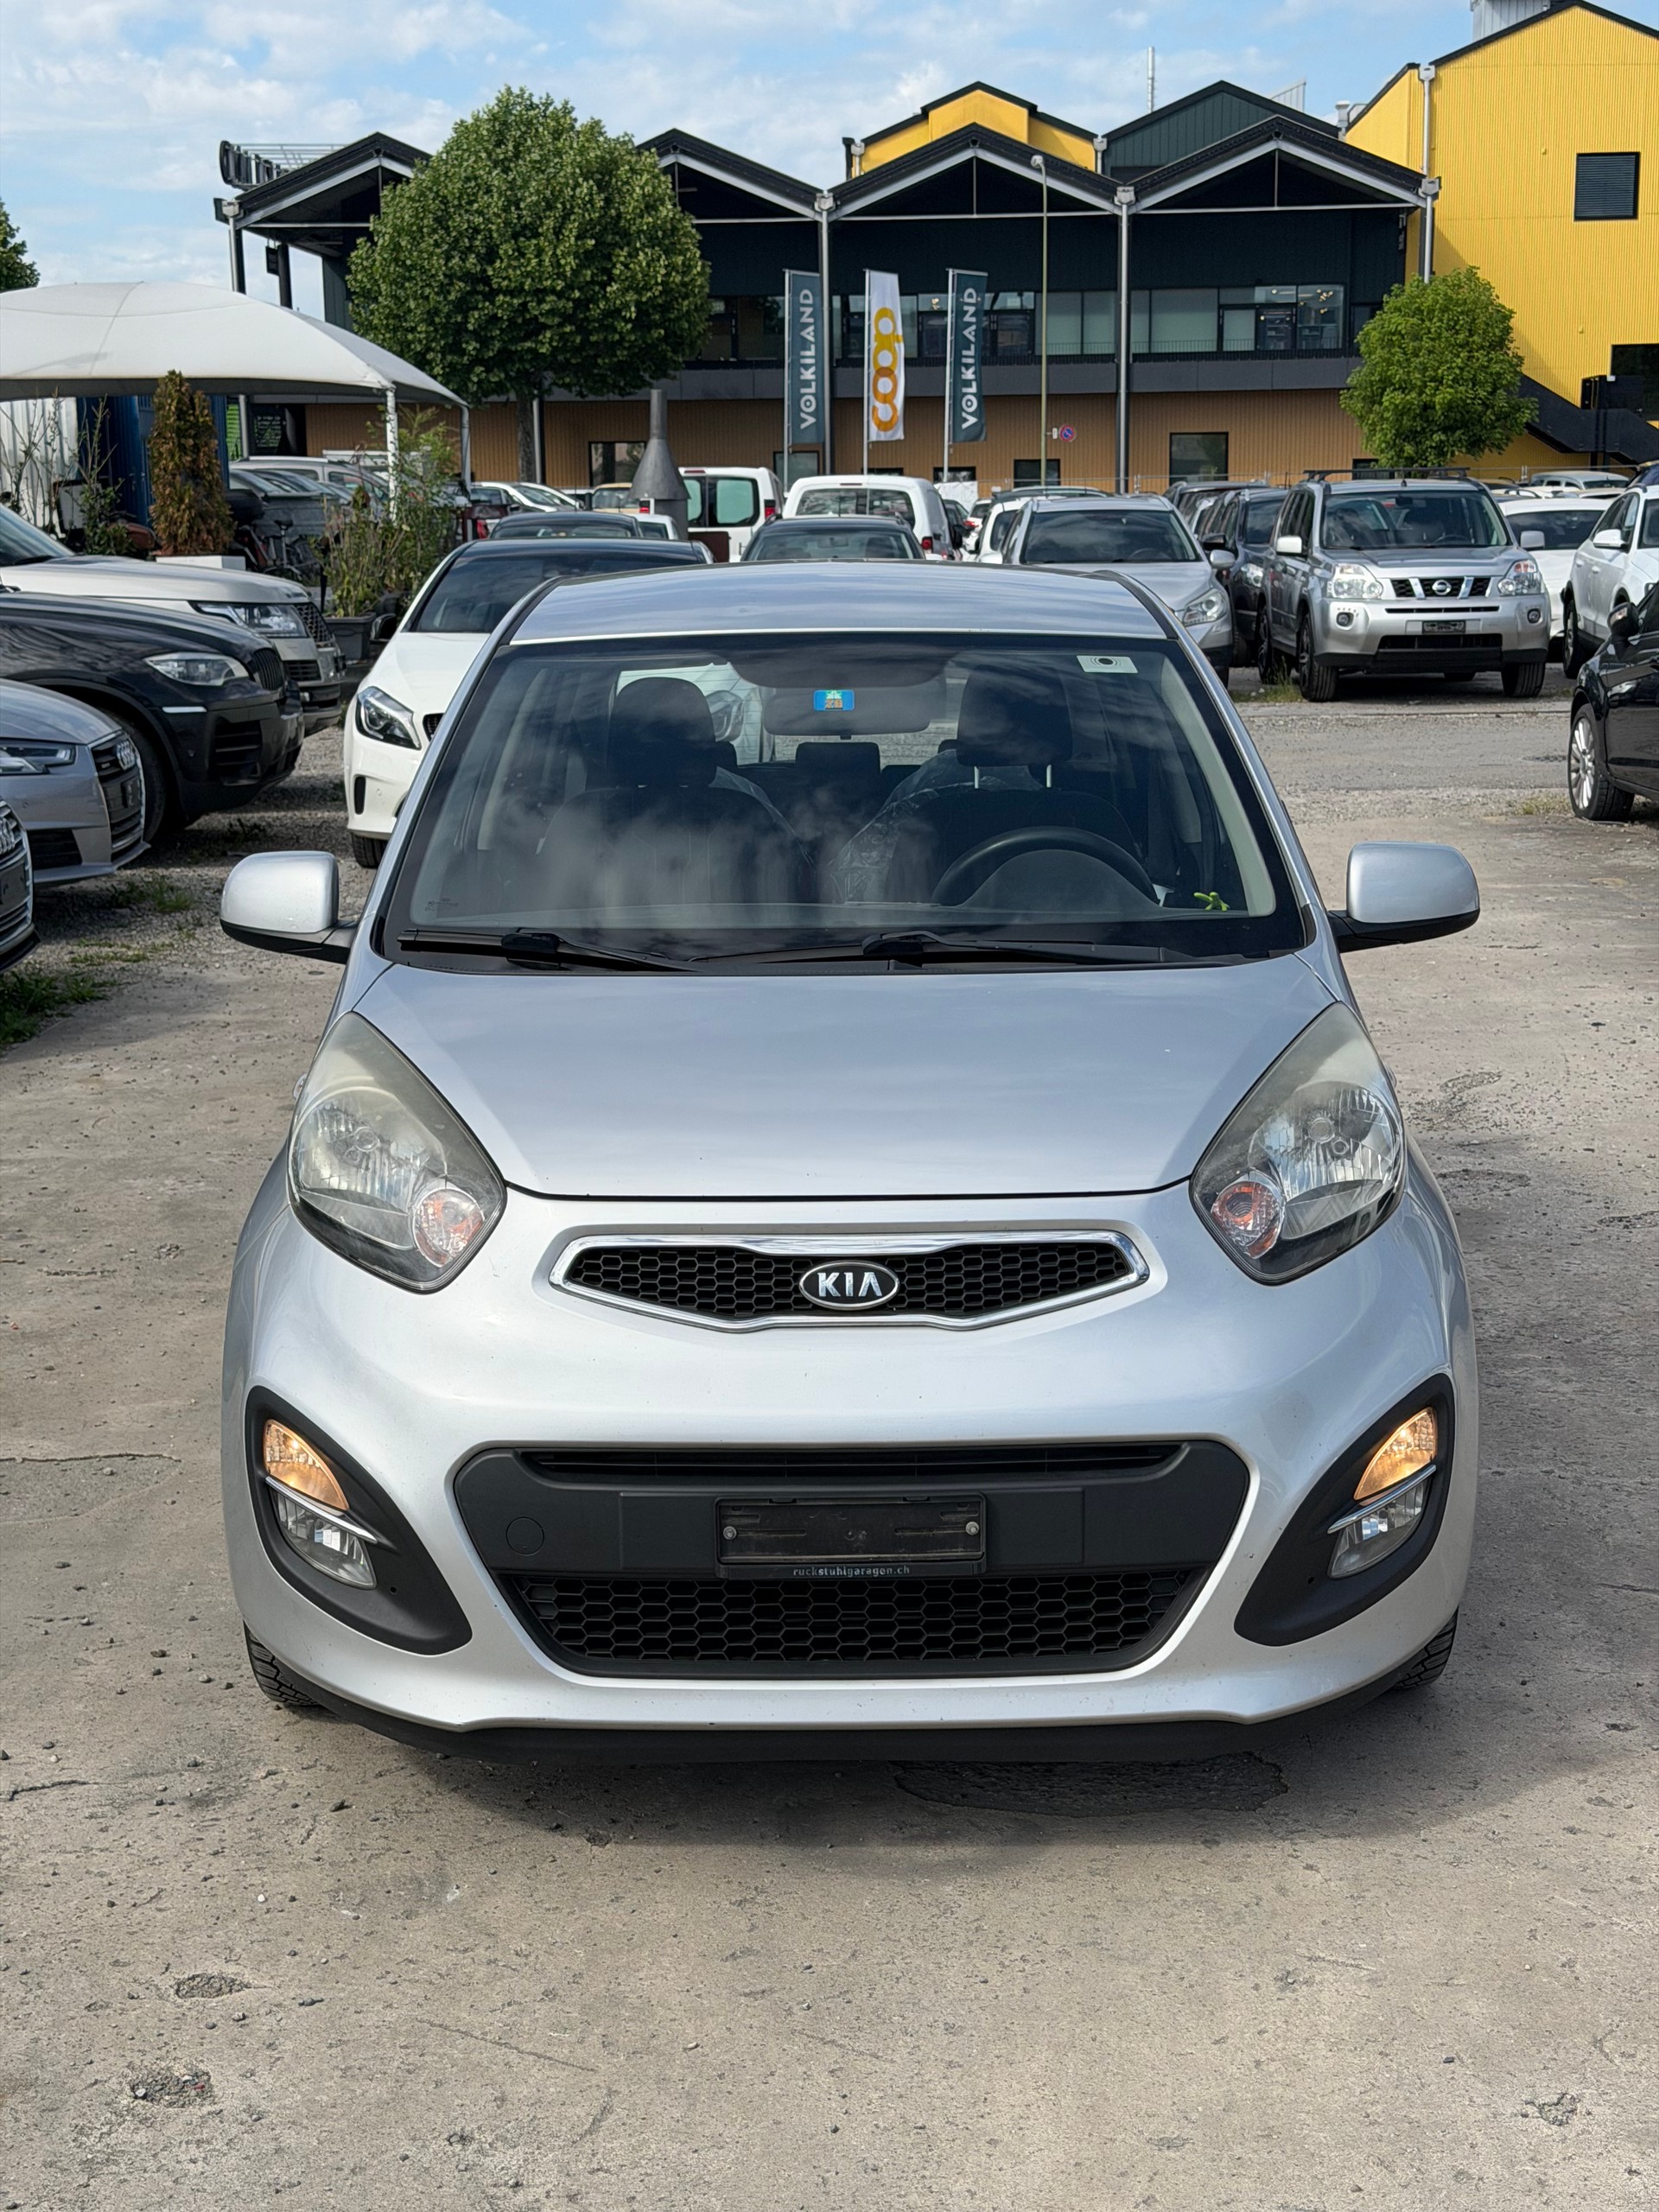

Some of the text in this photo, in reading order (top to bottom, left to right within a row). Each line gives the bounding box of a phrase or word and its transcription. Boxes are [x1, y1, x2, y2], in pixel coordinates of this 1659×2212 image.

[799, 289, 817, 429] VOLKILAND
[871, 307, 903, 432] coop
[961, 288, 978, 429] VOLKILAND
[817, 1271, 883, 1297] KIA
[793, 1565, 910, 1578] ruckstuhlgaragen.ch
